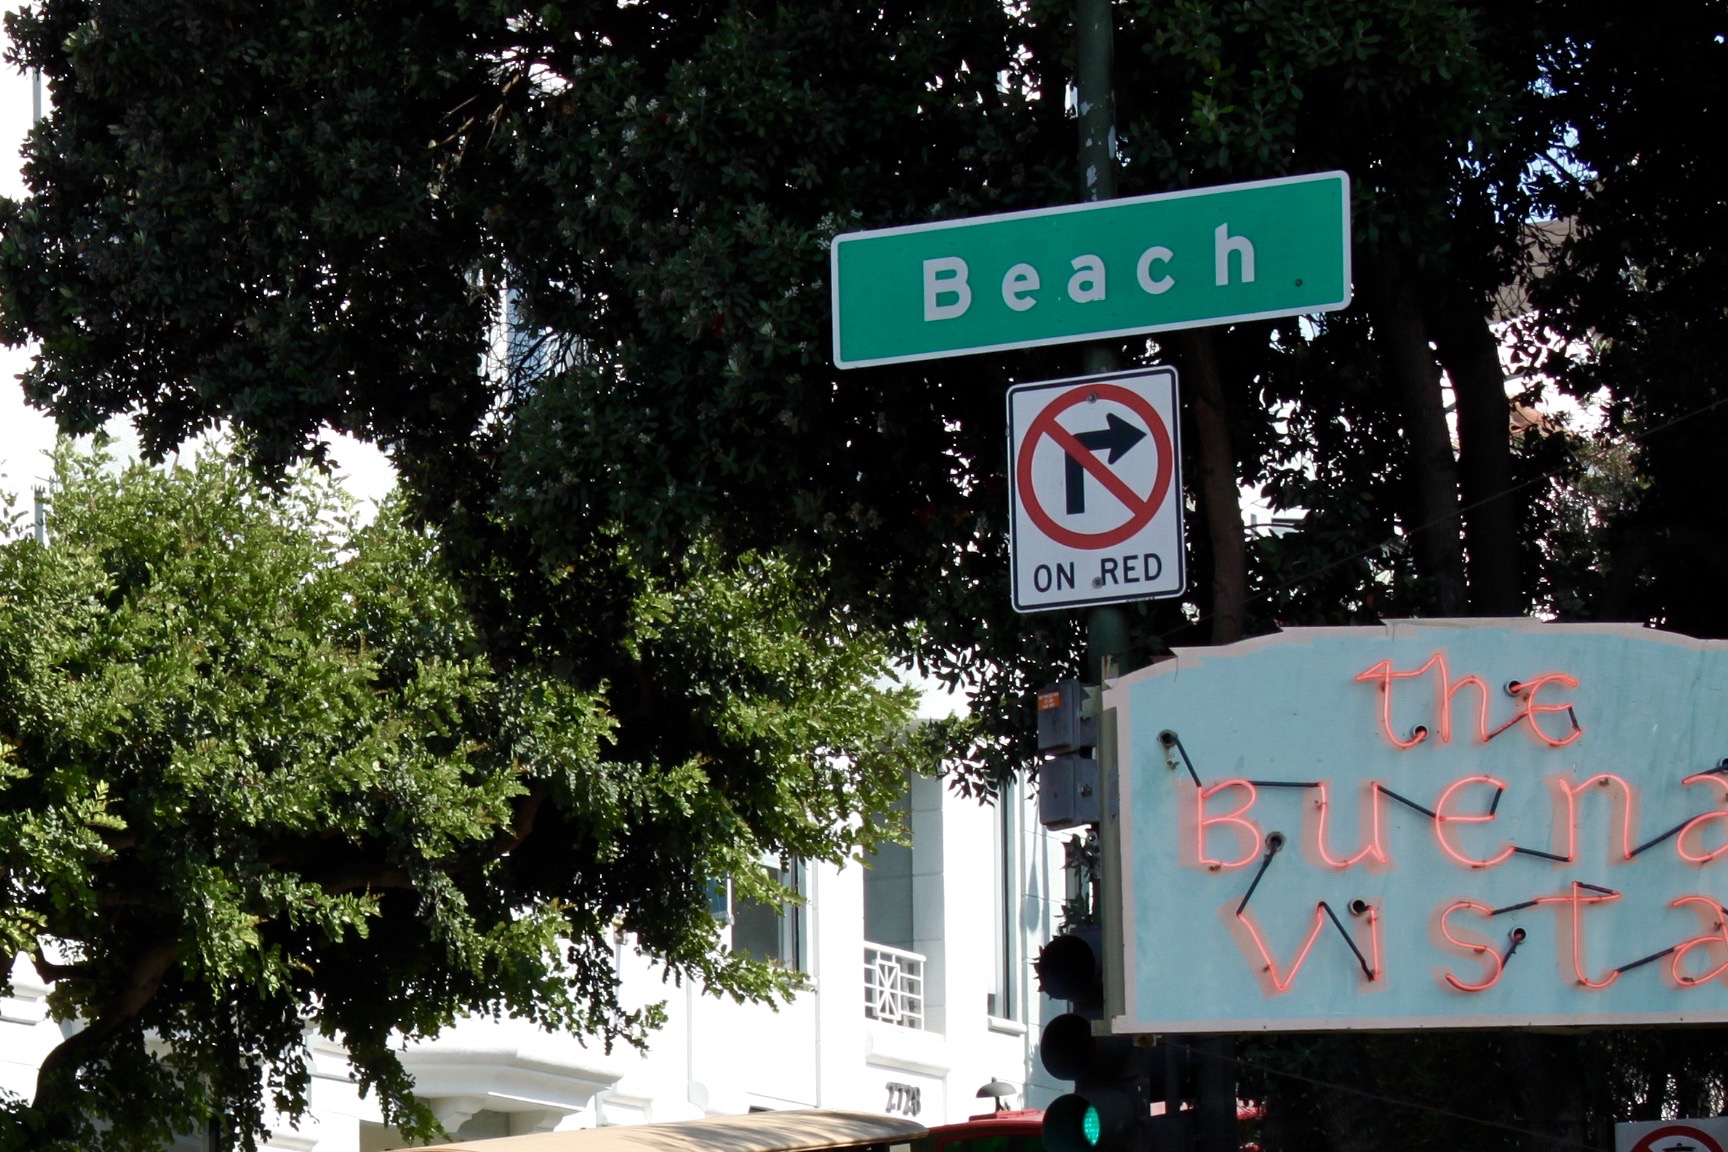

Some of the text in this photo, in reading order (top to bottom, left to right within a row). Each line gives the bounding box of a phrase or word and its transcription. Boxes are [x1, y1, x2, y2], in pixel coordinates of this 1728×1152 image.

[922, 222, 1256, 323] Beach
[1033, 552, 1163, 593] ON RED
[1352, 649, 1584, 750] the
[1186, 773, 1728, 869] Buena
[1228, 880, 1728, 998] Vista
